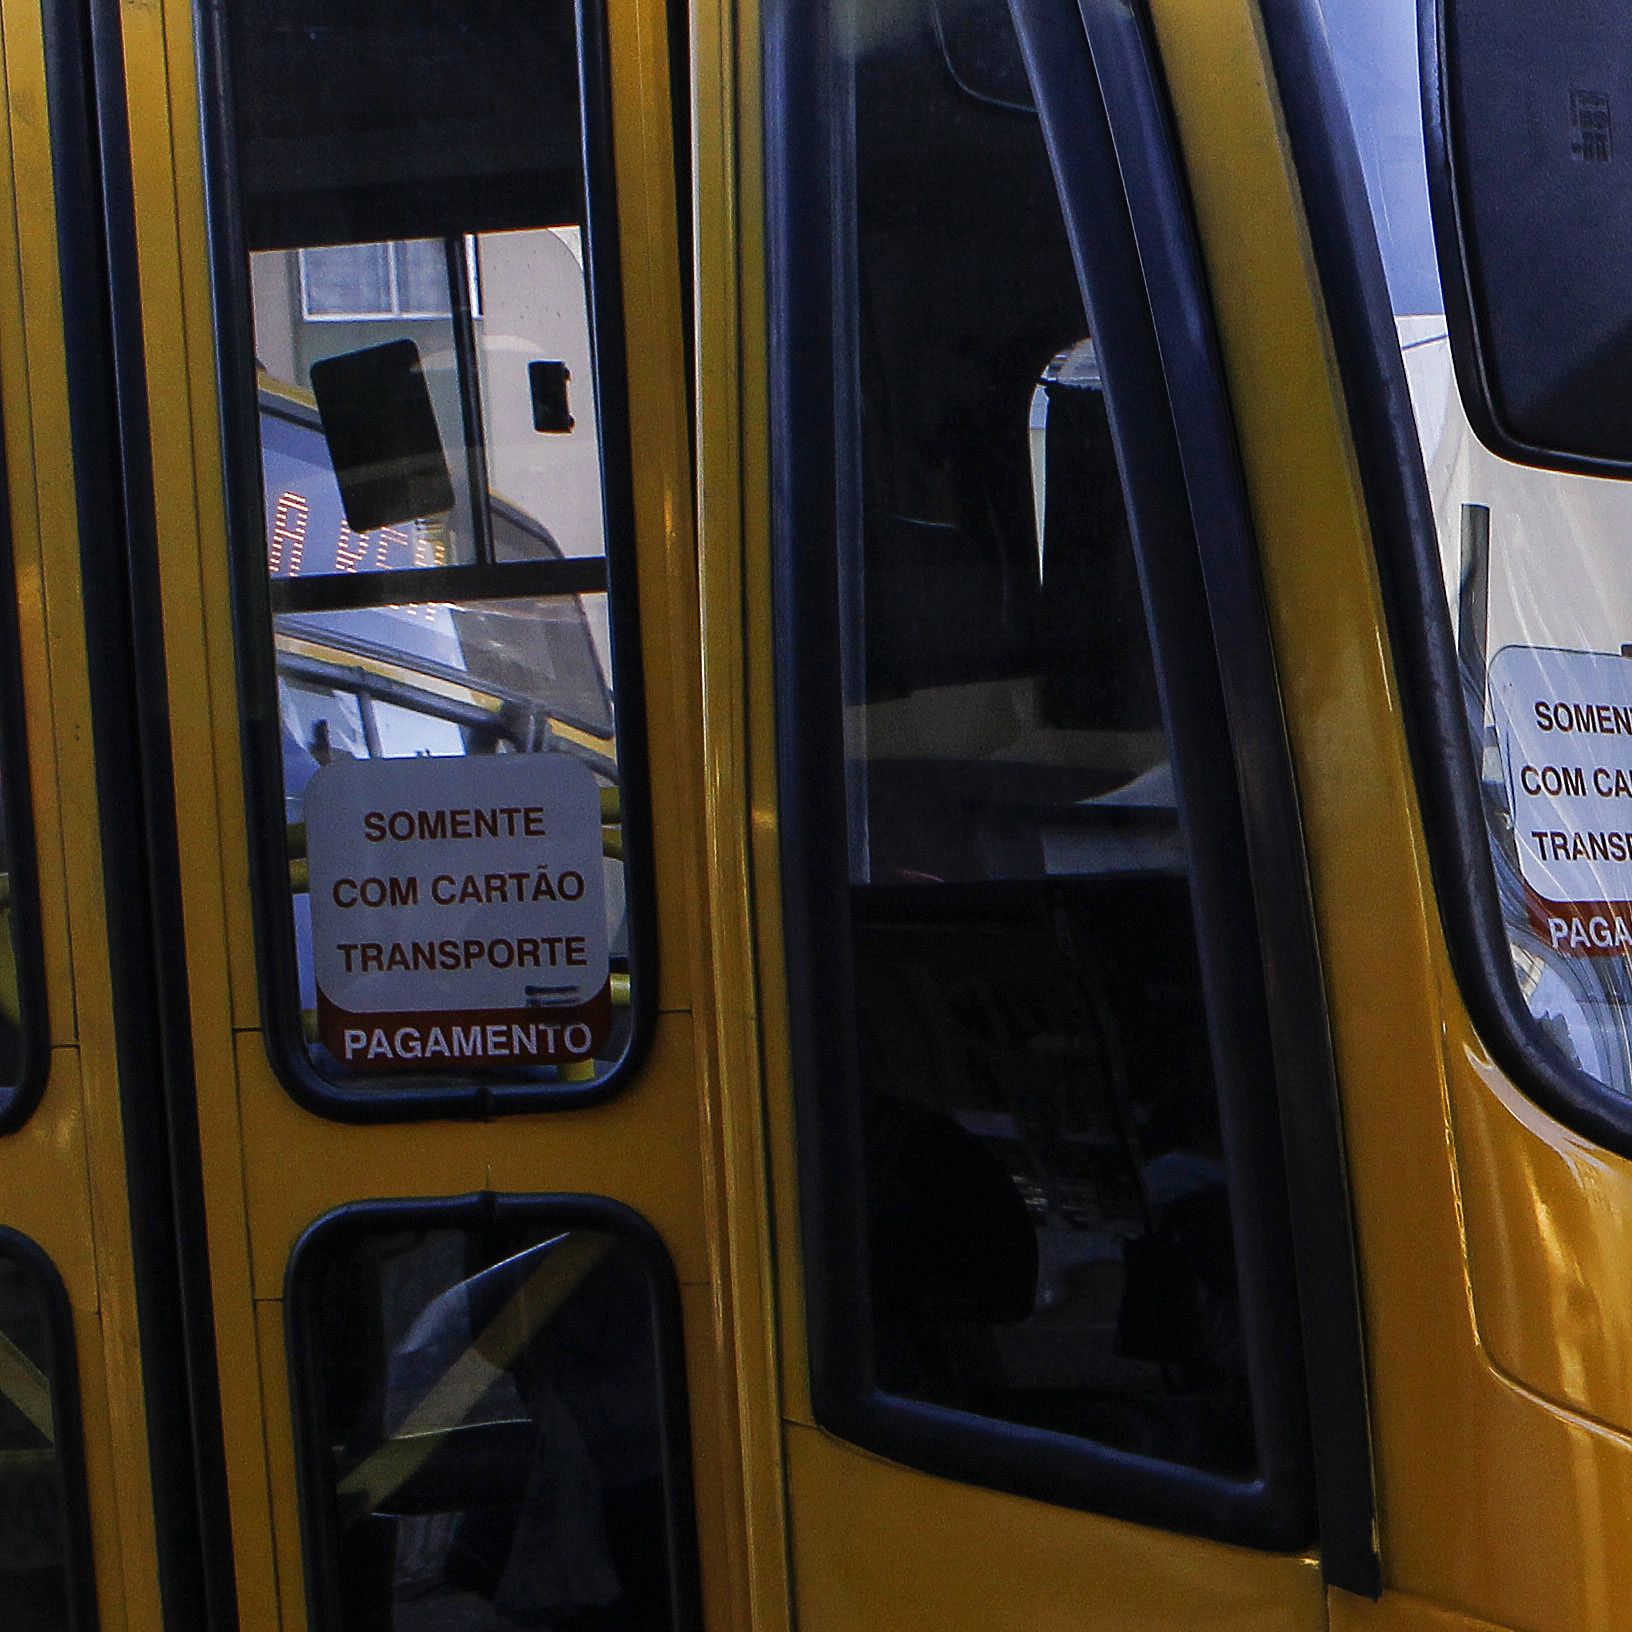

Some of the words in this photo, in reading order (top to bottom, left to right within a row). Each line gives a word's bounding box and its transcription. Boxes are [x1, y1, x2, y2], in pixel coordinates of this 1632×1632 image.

[1521, 765, 1586, 797] COM
[364, 807, 546, 842] SOMENTE
[333, 877, 419, 908] COM
[431, 865, 586, 904] CARTÃO
[337, 936, 588, 974] TRANSPORTE
[343, 1023, 592, 1060] PAGAMENTO
